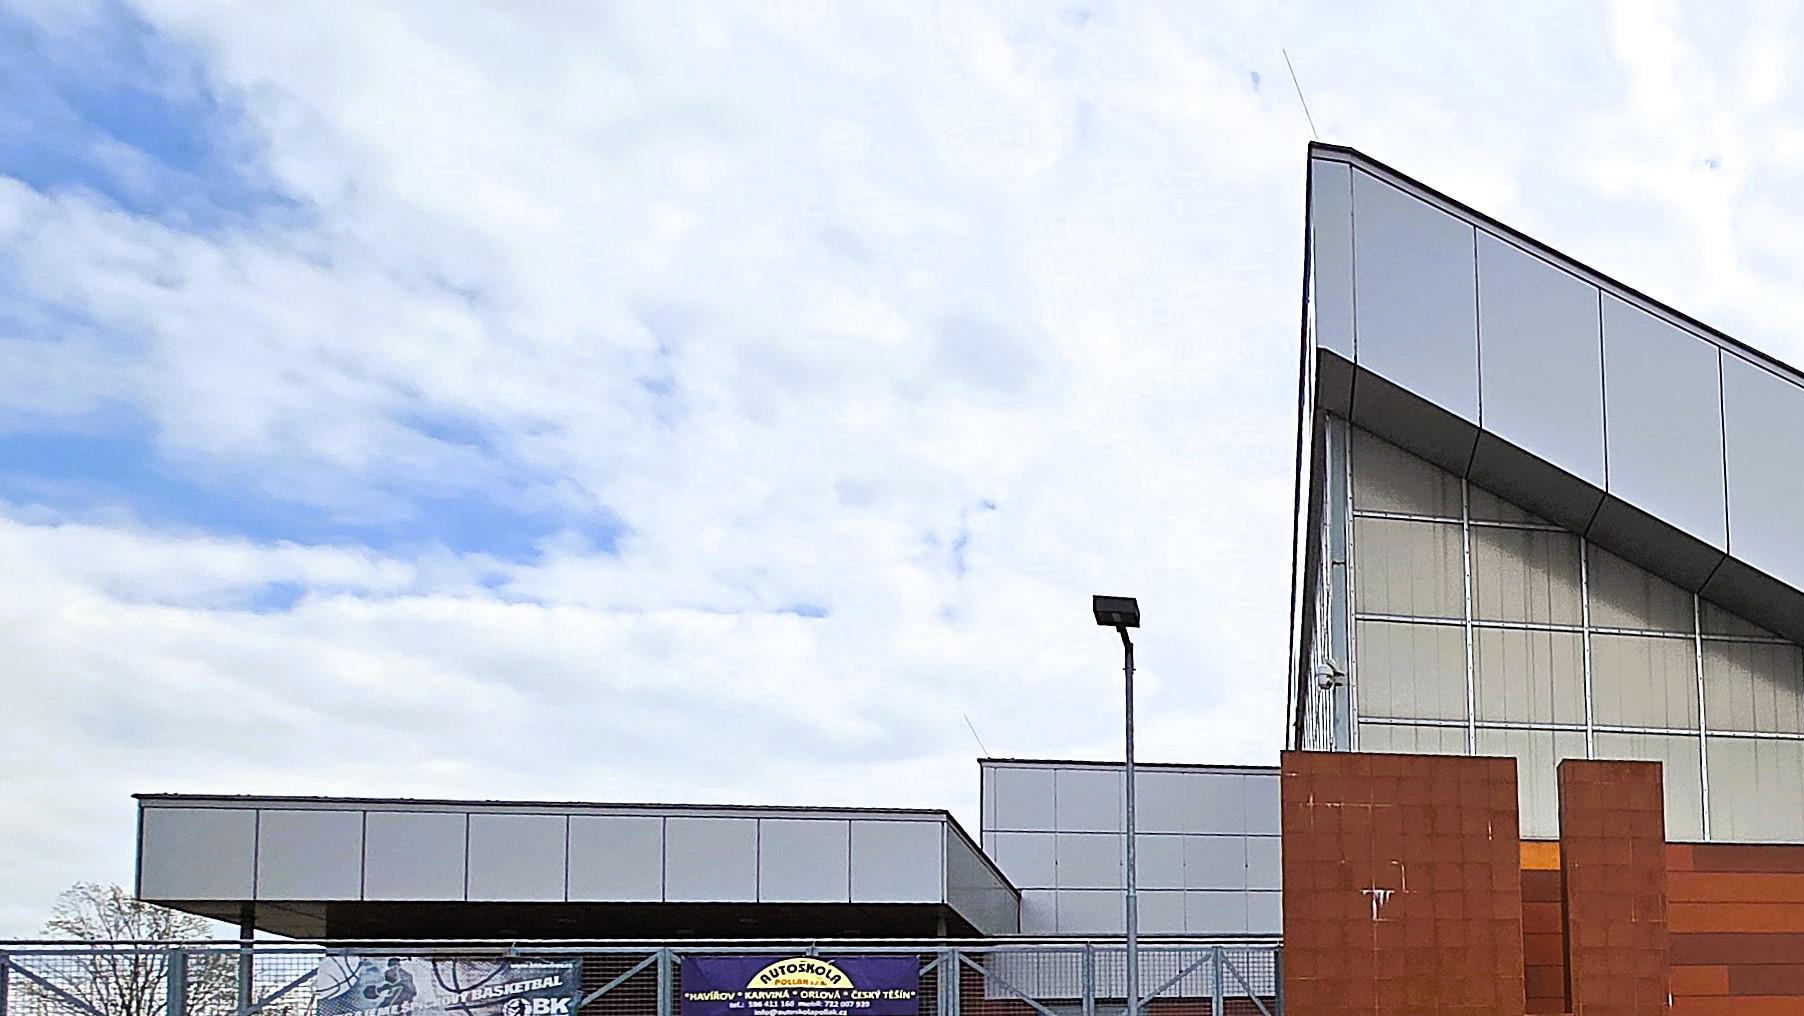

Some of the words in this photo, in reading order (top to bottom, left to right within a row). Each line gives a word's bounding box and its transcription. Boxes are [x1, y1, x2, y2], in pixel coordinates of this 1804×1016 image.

[760, 960, 842, 985] AUTOŠKOLA
[472, 975, 563, 1002] BASKETBAL
[744, 989, 790, 1000] KARVINÁ
[800, 989, 841, 1000] ORLOVÁ
[850, 989, 880, 1000] ČESKÝ
[533, 997, 571, 1015] BK
